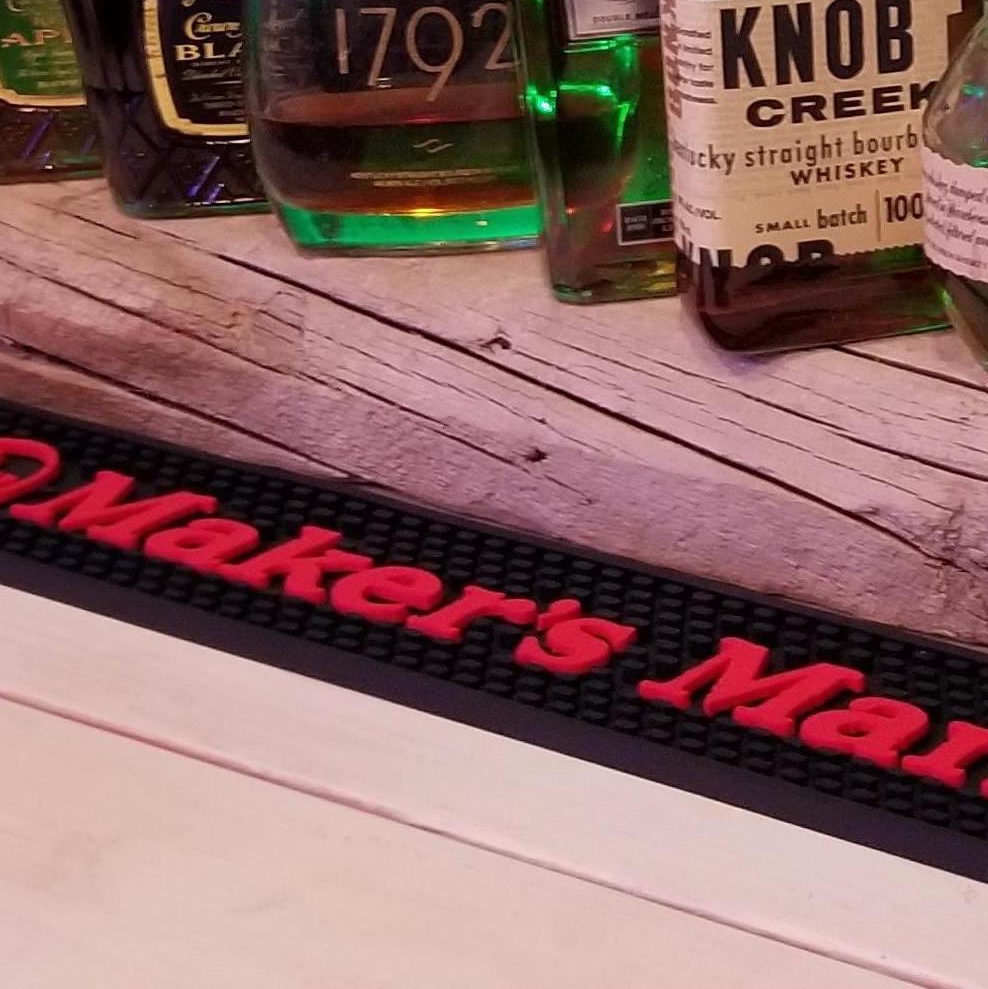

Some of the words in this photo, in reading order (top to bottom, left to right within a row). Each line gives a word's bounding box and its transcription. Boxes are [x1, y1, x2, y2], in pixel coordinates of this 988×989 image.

[335, 2, 519, 102] 1792
[745, 134, 843, 168] straight
[791, 157, 904, 186] WHISKEY
[756, 217, 811, 234] SMALL
[817, 203, 867, 229] batch
[11, 469, 637, 673] Maker's
